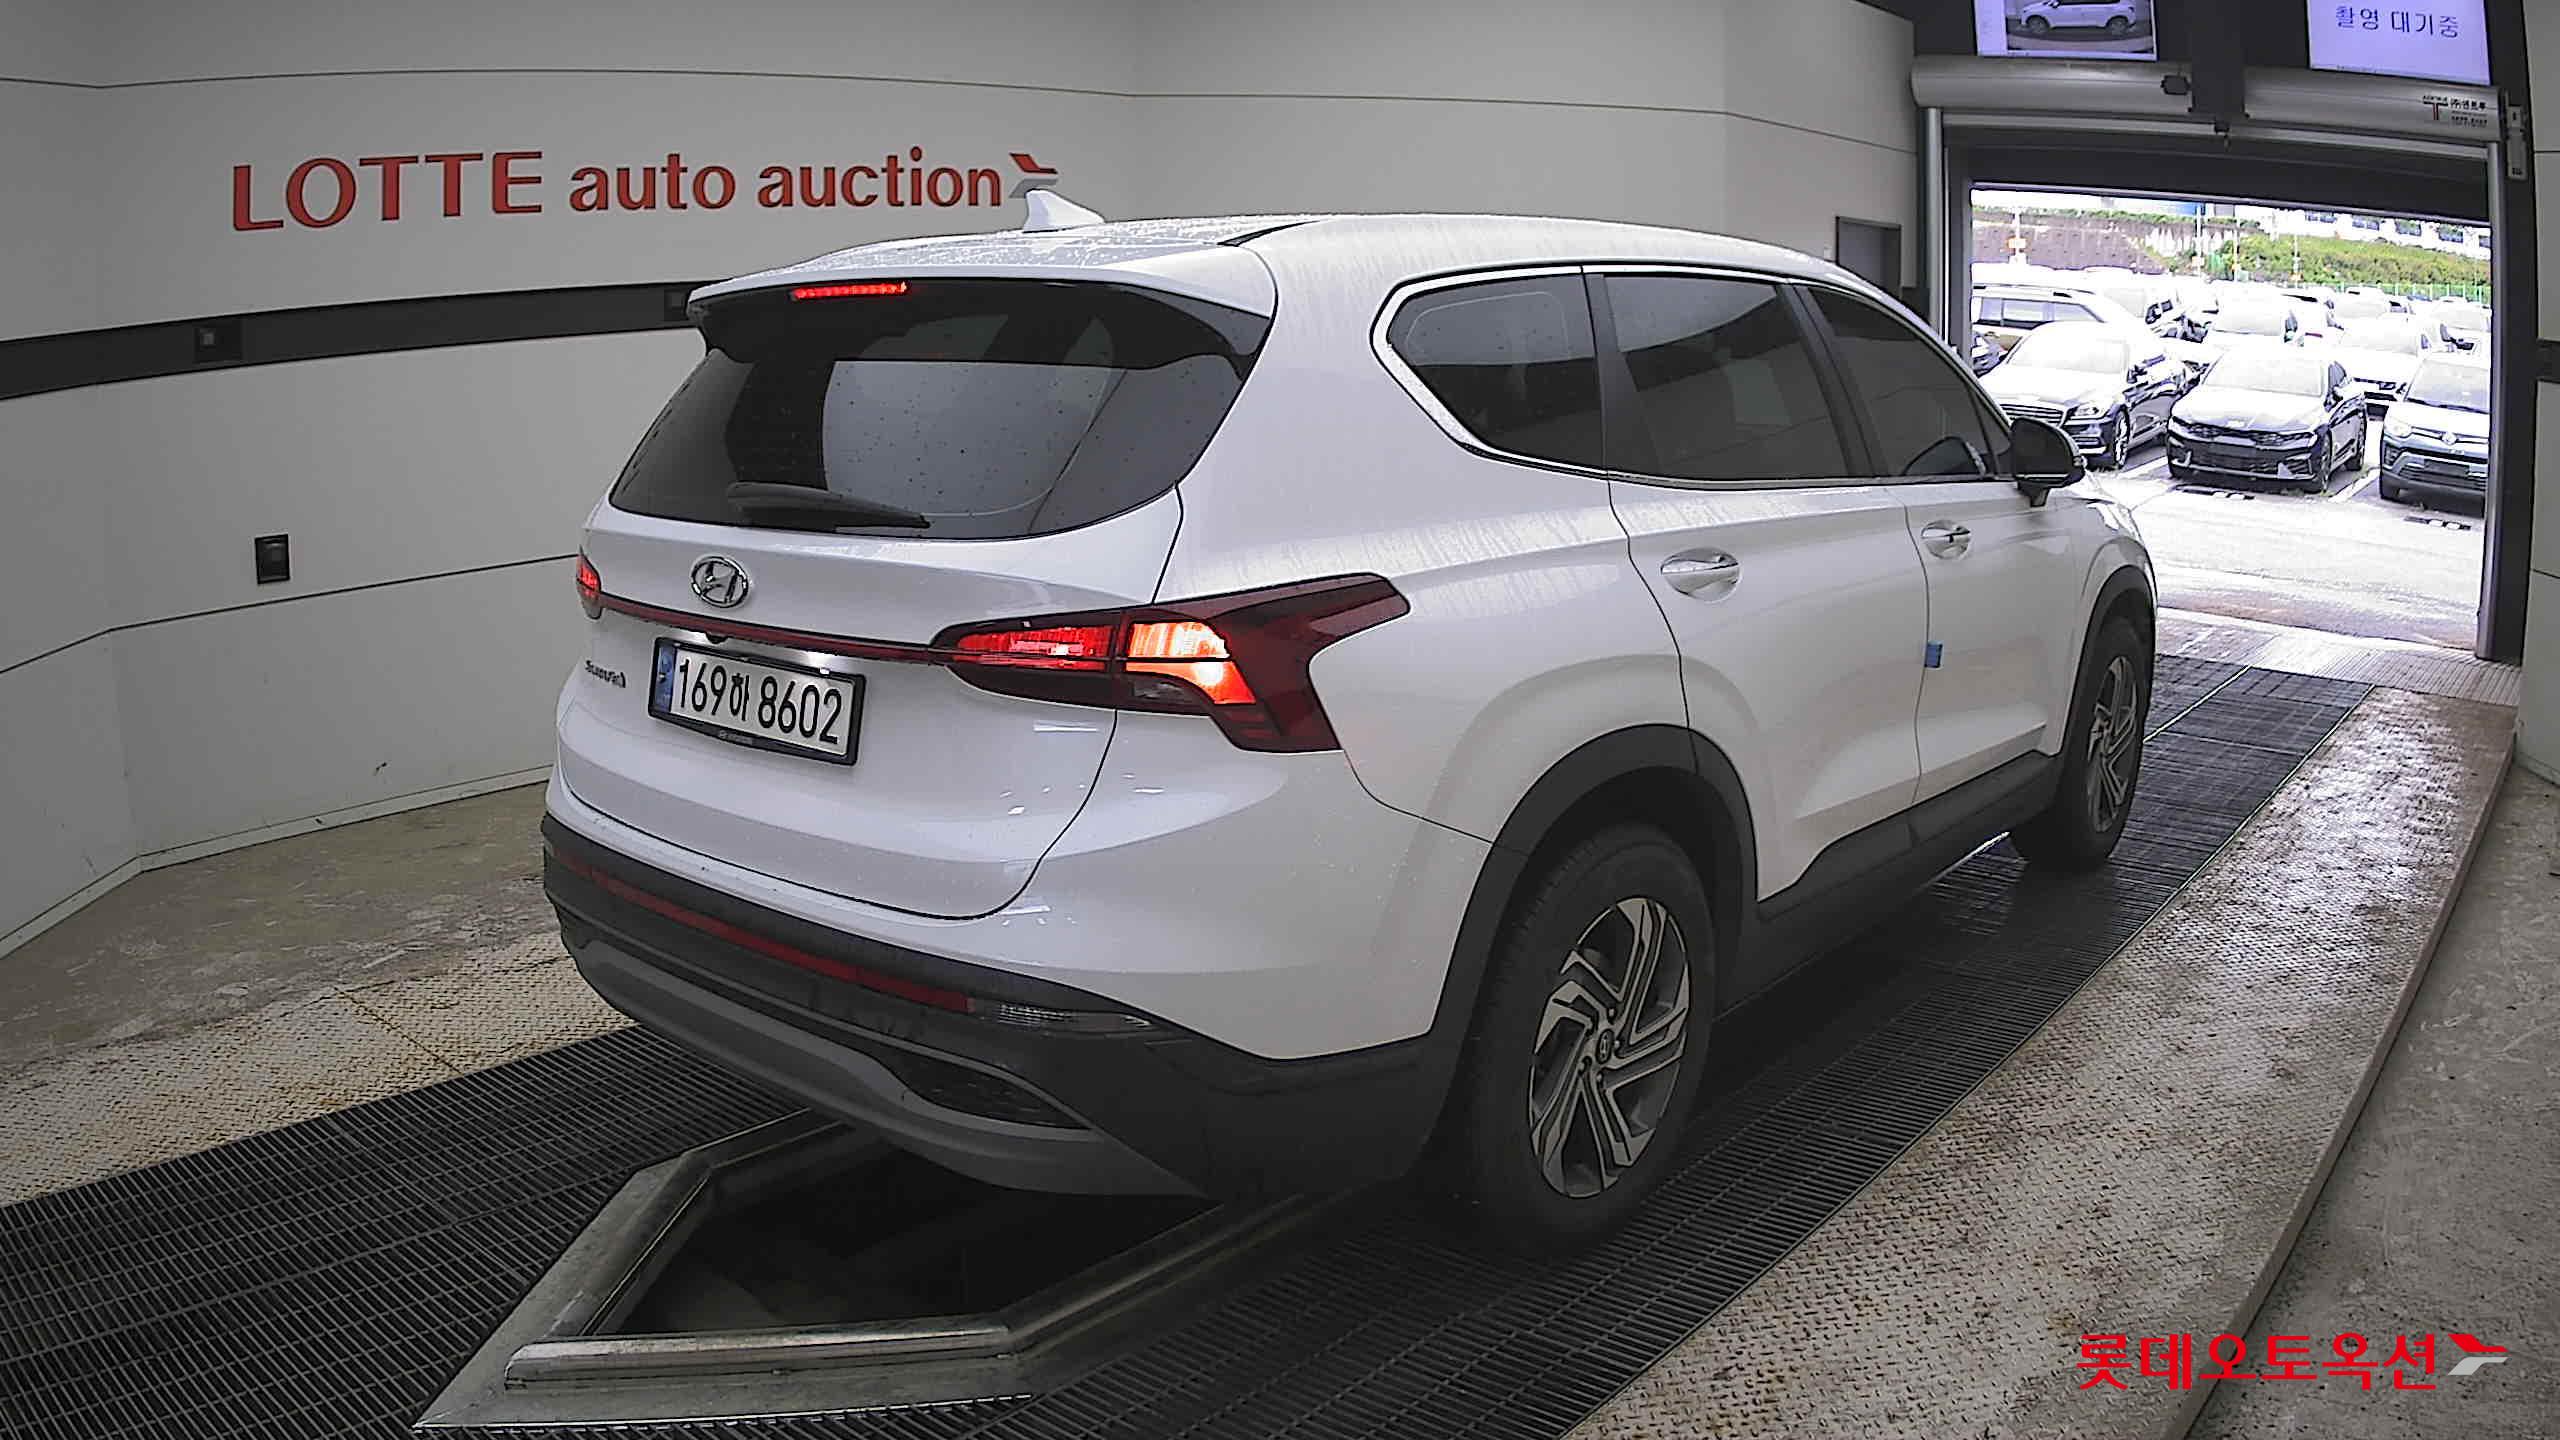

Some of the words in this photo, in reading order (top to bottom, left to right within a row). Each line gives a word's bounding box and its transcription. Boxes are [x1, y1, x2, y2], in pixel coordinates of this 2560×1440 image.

[2390, 10, 2458, 39] 대기중
[232, 150, 543, 232] LOTTE
[568, 153, 737, 212] auto
[757, 146, 1003, 210] auction
[679, 658, 751, 722] 169하
[757, 675, 843, 746] 8602
